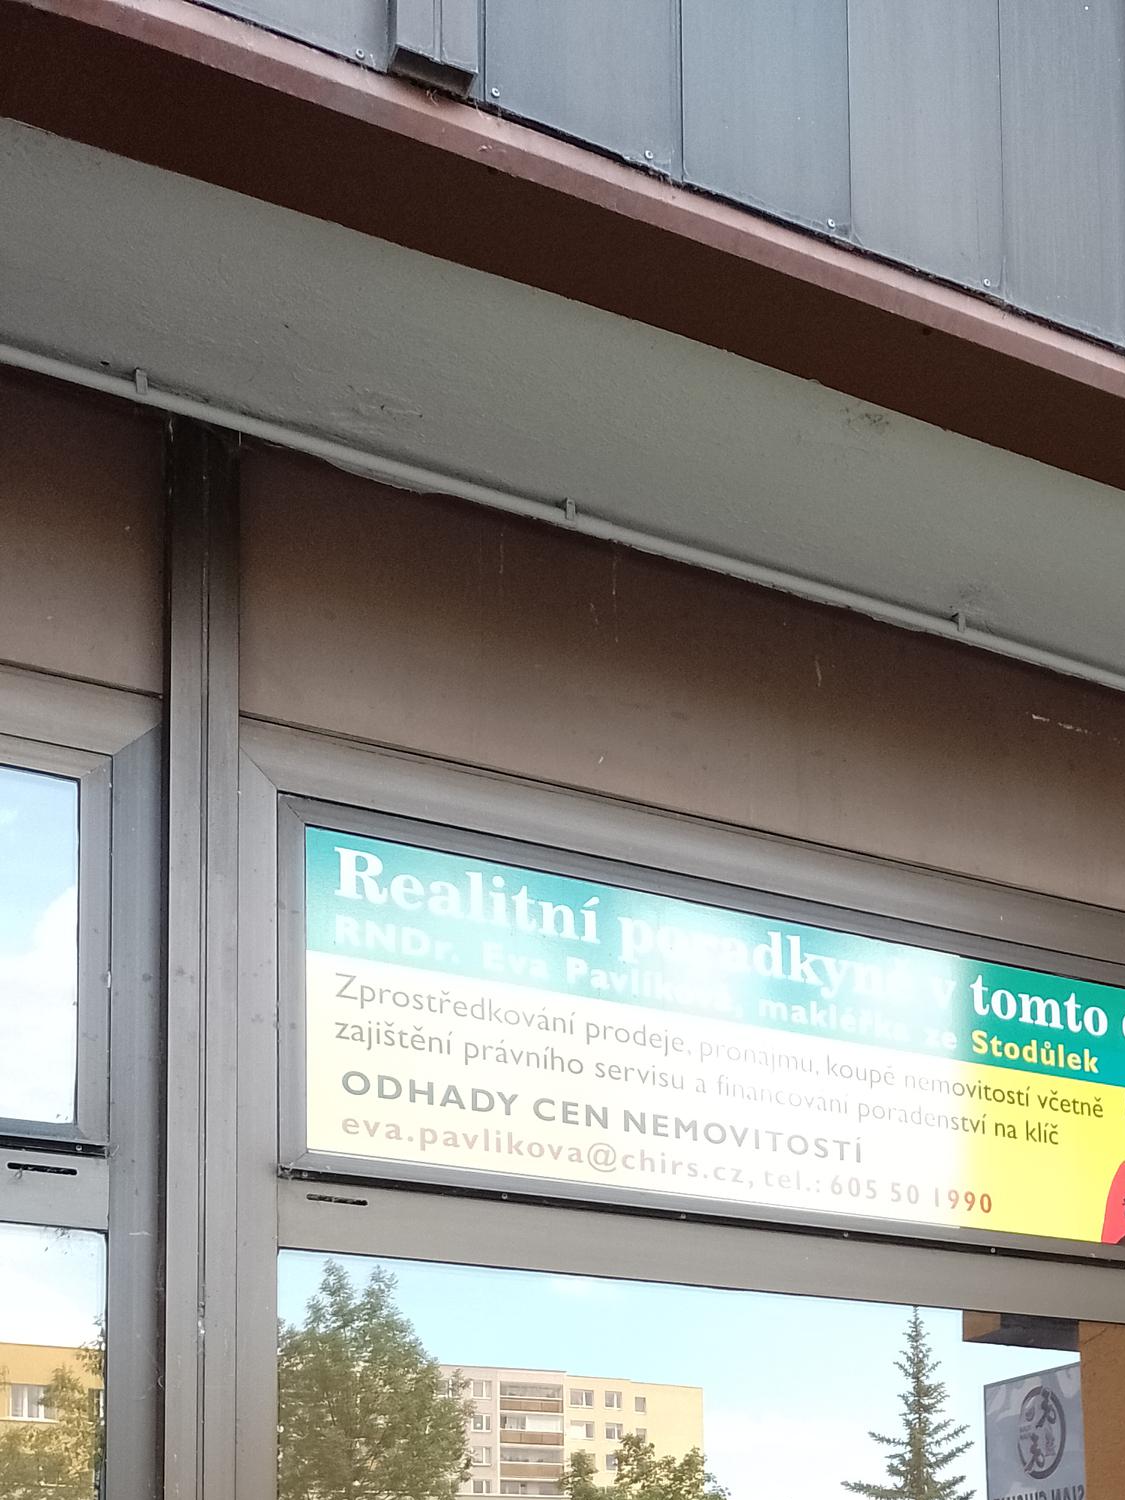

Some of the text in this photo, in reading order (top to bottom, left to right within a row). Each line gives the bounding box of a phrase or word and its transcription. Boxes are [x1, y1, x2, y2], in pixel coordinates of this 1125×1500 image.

[334, 846, 601, 945] Realitní
[969, 972, 1109, 1037] tomto
[334, 914, 459, 964] RNDr.
[482, 942, 549, 982] Eva
[923, 1025, 958, 1050] ze
[971, 1030, 1099, 1074] Stodůlek
[334, 1016, 1059, 1146] zajištění právního servisu a financování poradenství na klíč
[335, 972, 575, 1036] Zprostředkování
[585, 1018, 692, 1058] prodeje,
[905, 1071, 1030, 1108] nemovitostí
[1037, 1085, 1104, 1119] včetně
[341, 1070, 863, 1164] ODHADY CEN NEMOVITOSTÍ
[829, 1176, 878, 1201] 605
[890, 1183, 919, 1205] 50
[934, 1186, 993, 1215] 1990
